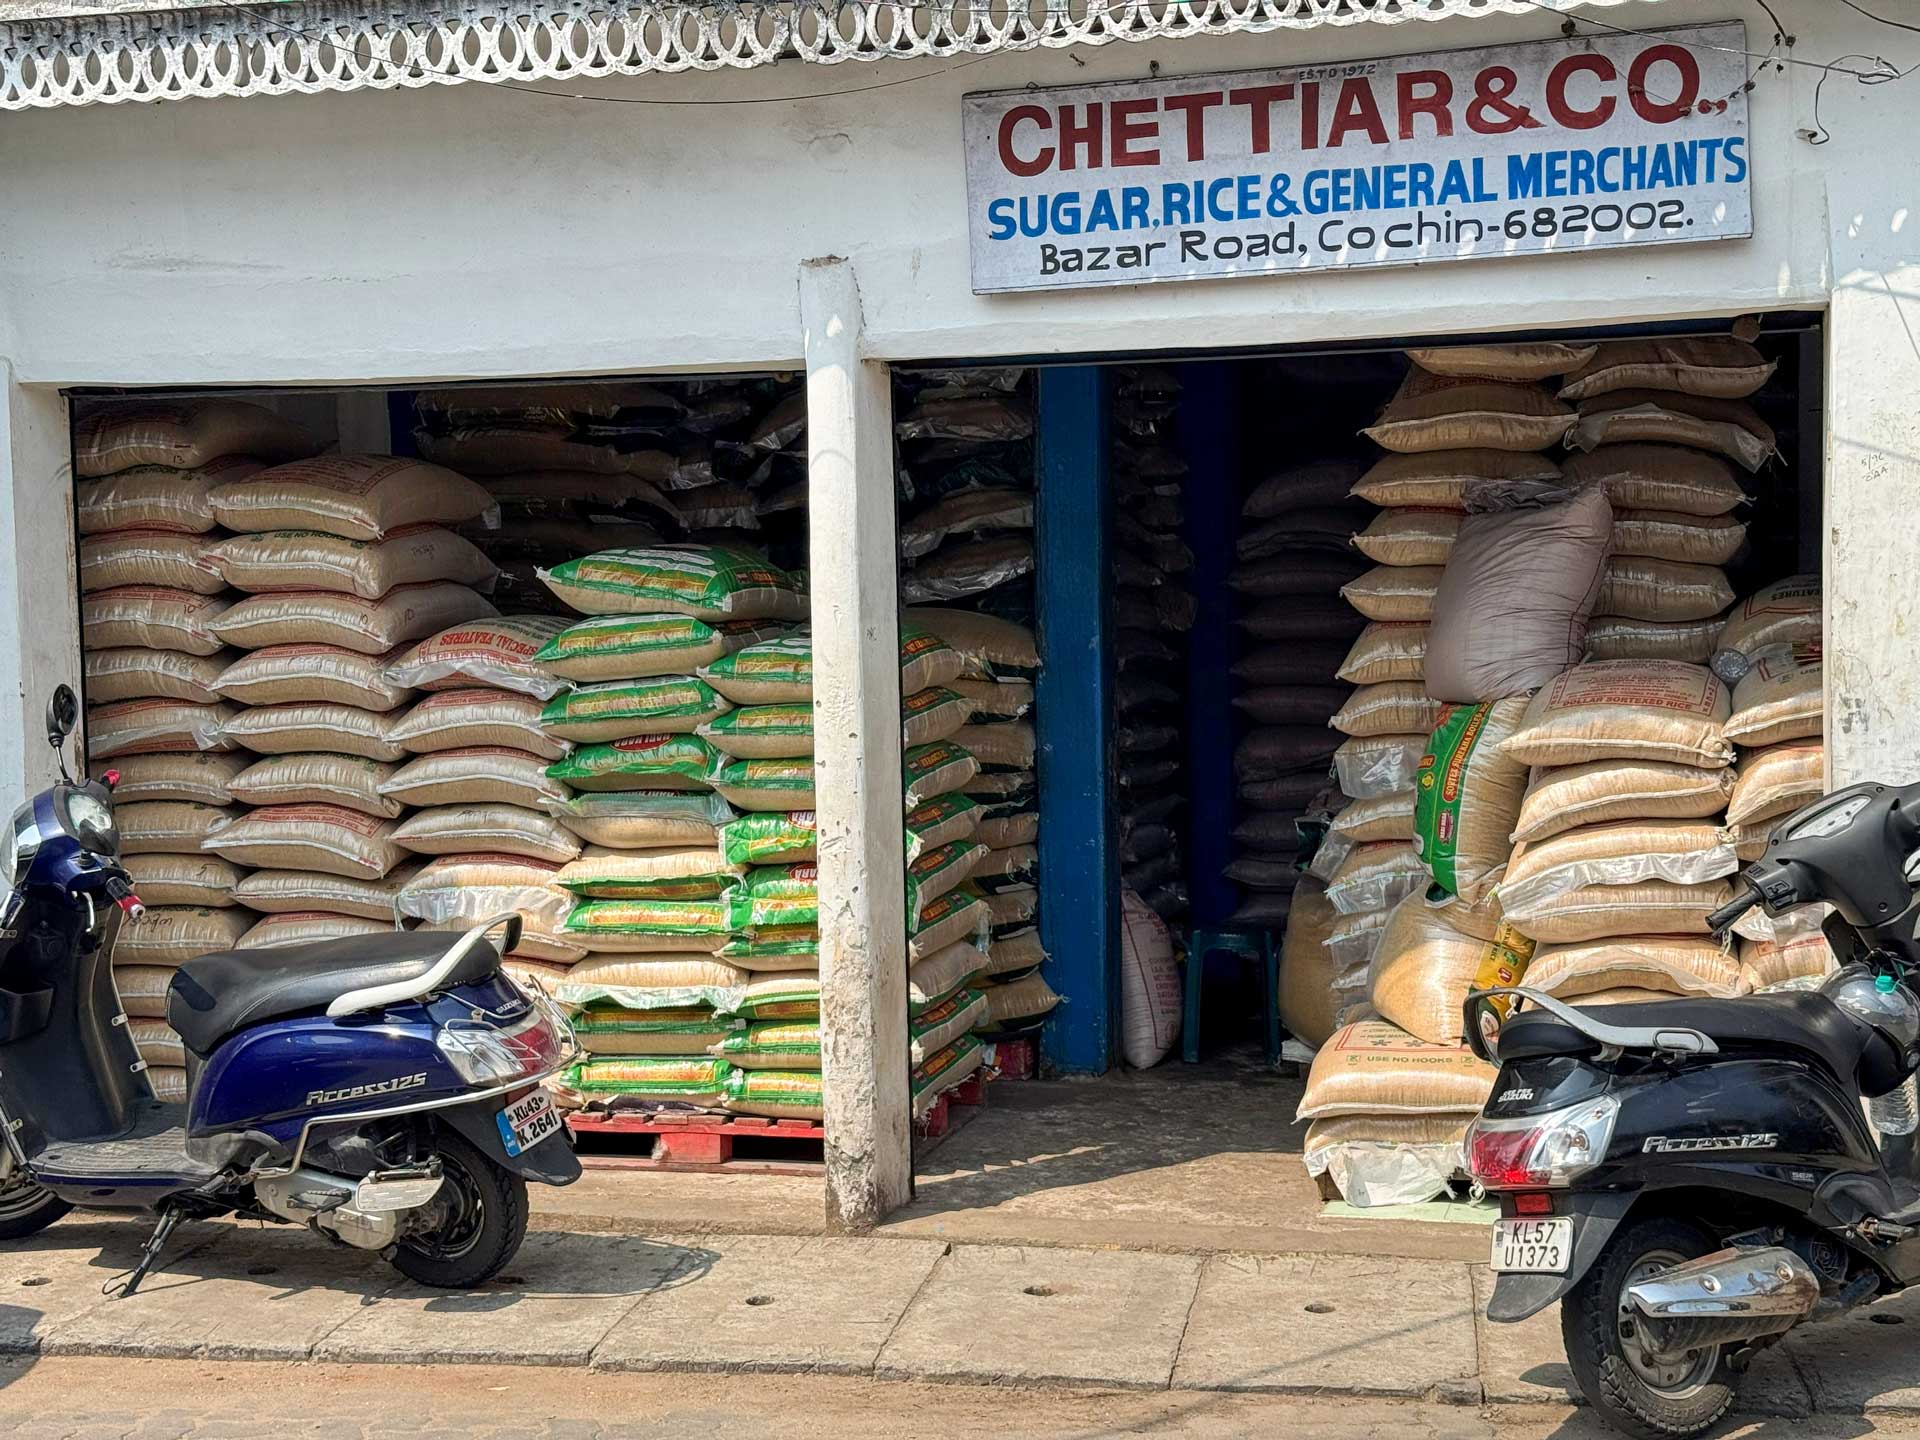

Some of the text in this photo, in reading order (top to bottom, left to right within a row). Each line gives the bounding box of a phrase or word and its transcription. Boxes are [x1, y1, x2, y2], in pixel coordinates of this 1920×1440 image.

[1341, 63, 1376, 77] 1972
[1507, 137, 1746, 200] MERCHANTS
[1040, 242, 1166, 275] Bazar
[440, 631, 539, 656] SPECIAL FEATURES
[1563, 695, 1692, 710] DOLLAR SORTEXED RICE
[1498, 1092, 1534, 1102] SUZUKI
[1512, 1222, 1557, 1245] KL57
[1504, 1246, 1560, 1268] U1373
